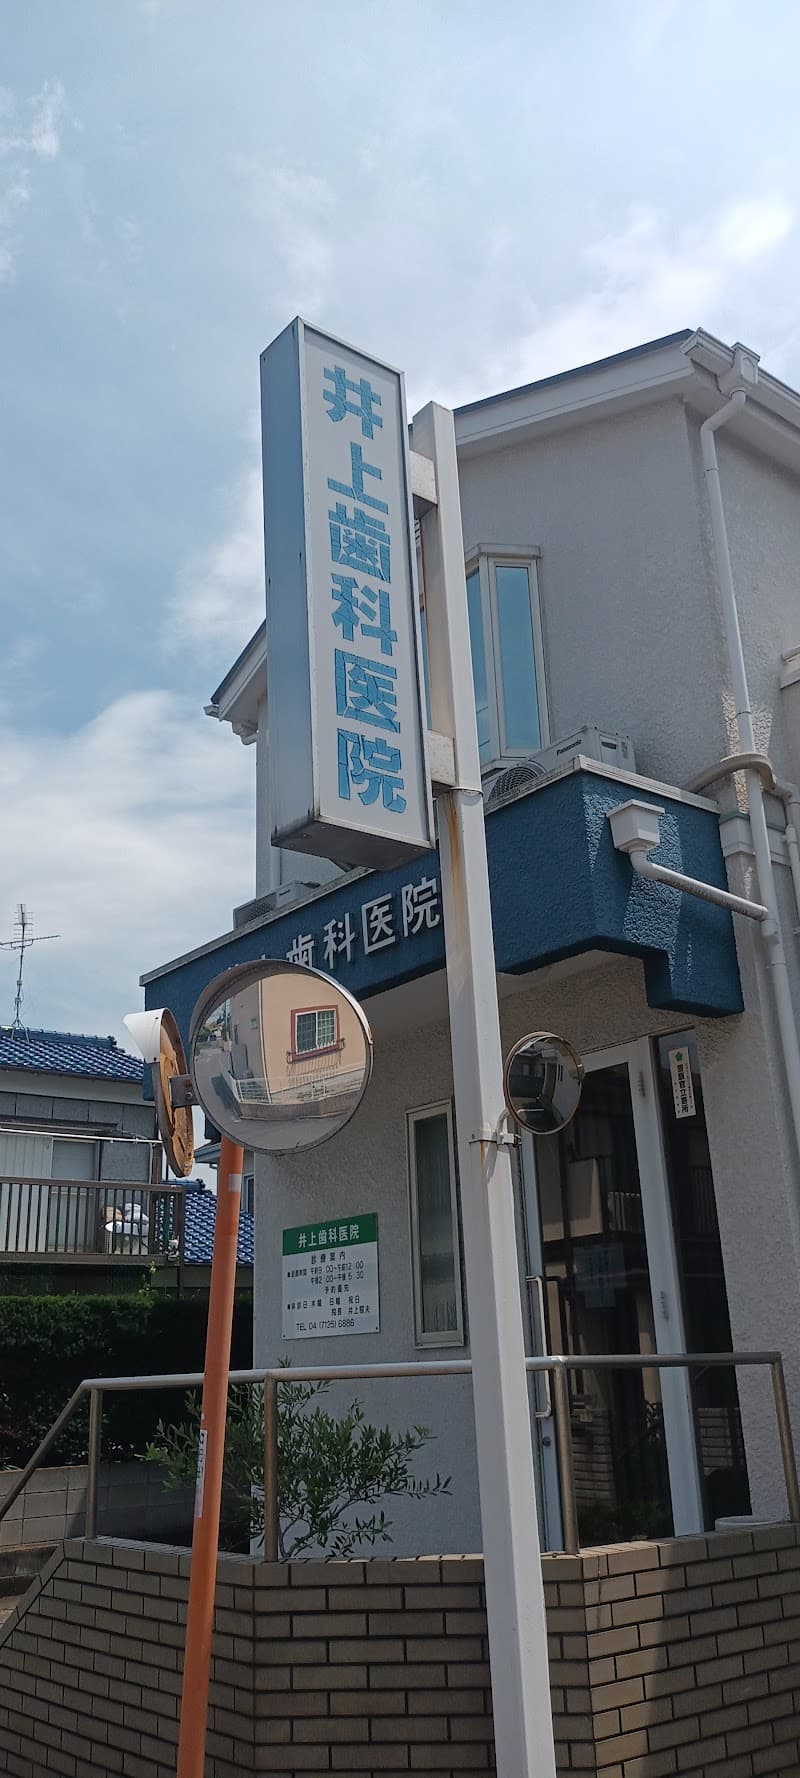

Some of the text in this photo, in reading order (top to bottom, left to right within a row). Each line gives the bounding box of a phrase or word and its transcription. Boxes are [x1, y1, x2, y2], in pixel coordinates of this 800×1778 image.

[322, 365, 407, 815] 井上歯科医院
[298, 1224, 360, 1248] 井上歯科医院
